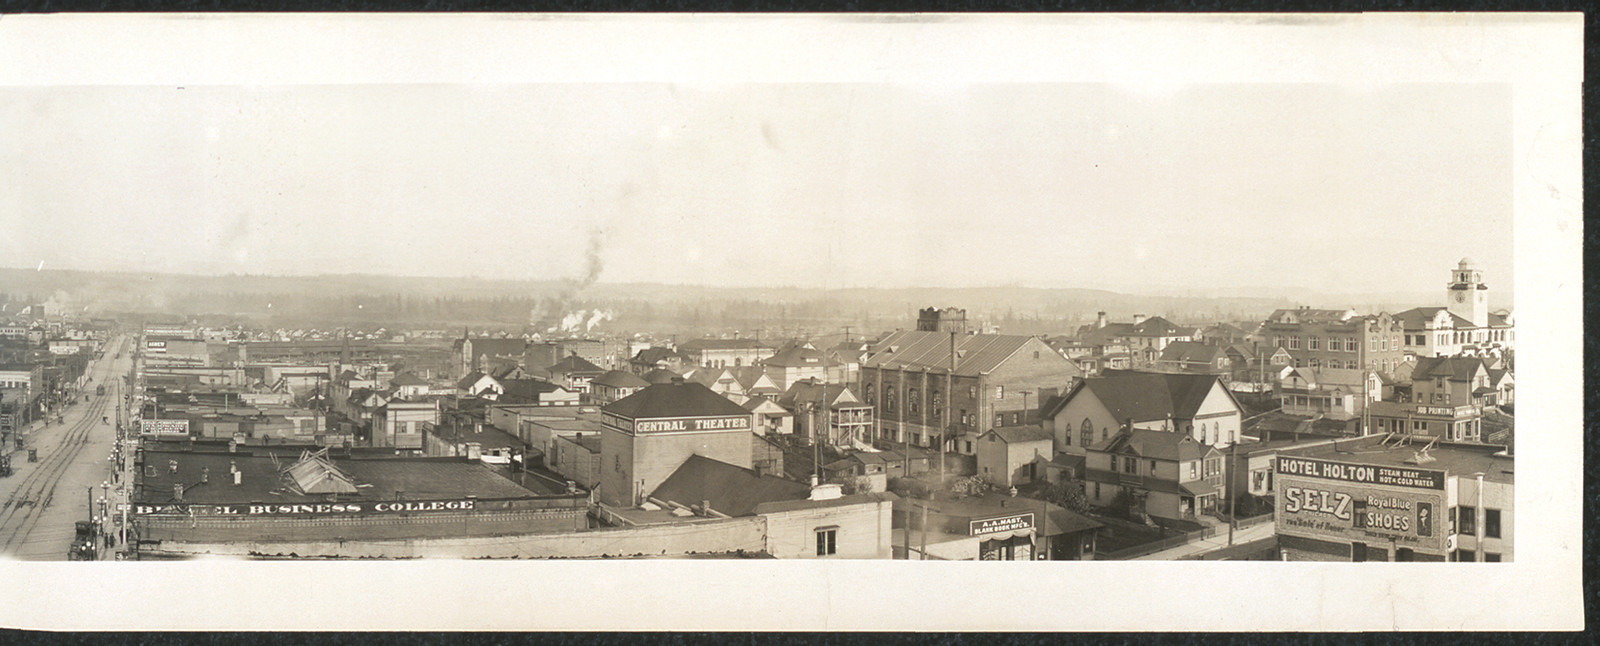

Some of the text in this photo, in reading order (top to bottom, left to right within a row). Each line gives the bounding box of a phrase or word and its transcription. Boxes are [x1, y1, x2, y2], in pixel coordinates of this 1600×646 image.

[1428, 406, 1454, 416] PRINTING
[637, 420, 687, 432] CENTRAL
[695, 418, 747, 429] THEATER
[1280, 459, 1375, 482] HOTEL HOLTON
[1379, 468, 1420, 479] STEAM HEAT
[1379, 475, 1392, 484] HOT
[1397, 477, 1414, 485] COLD
[1414, 479, 1434, 487] WATER
[250, 504, 361, 514] BUSINESS
[374, 501, 474, 512] COLLEGE
[1286, 487, 1352, 520] SELZ
[1367, 495, 1411, 510] Royal Blue
[1367, 511, 1409, 532] SHOES
[974, 526, 994, 535] BLANK
[994, 524, 1010, 532] BOOK
